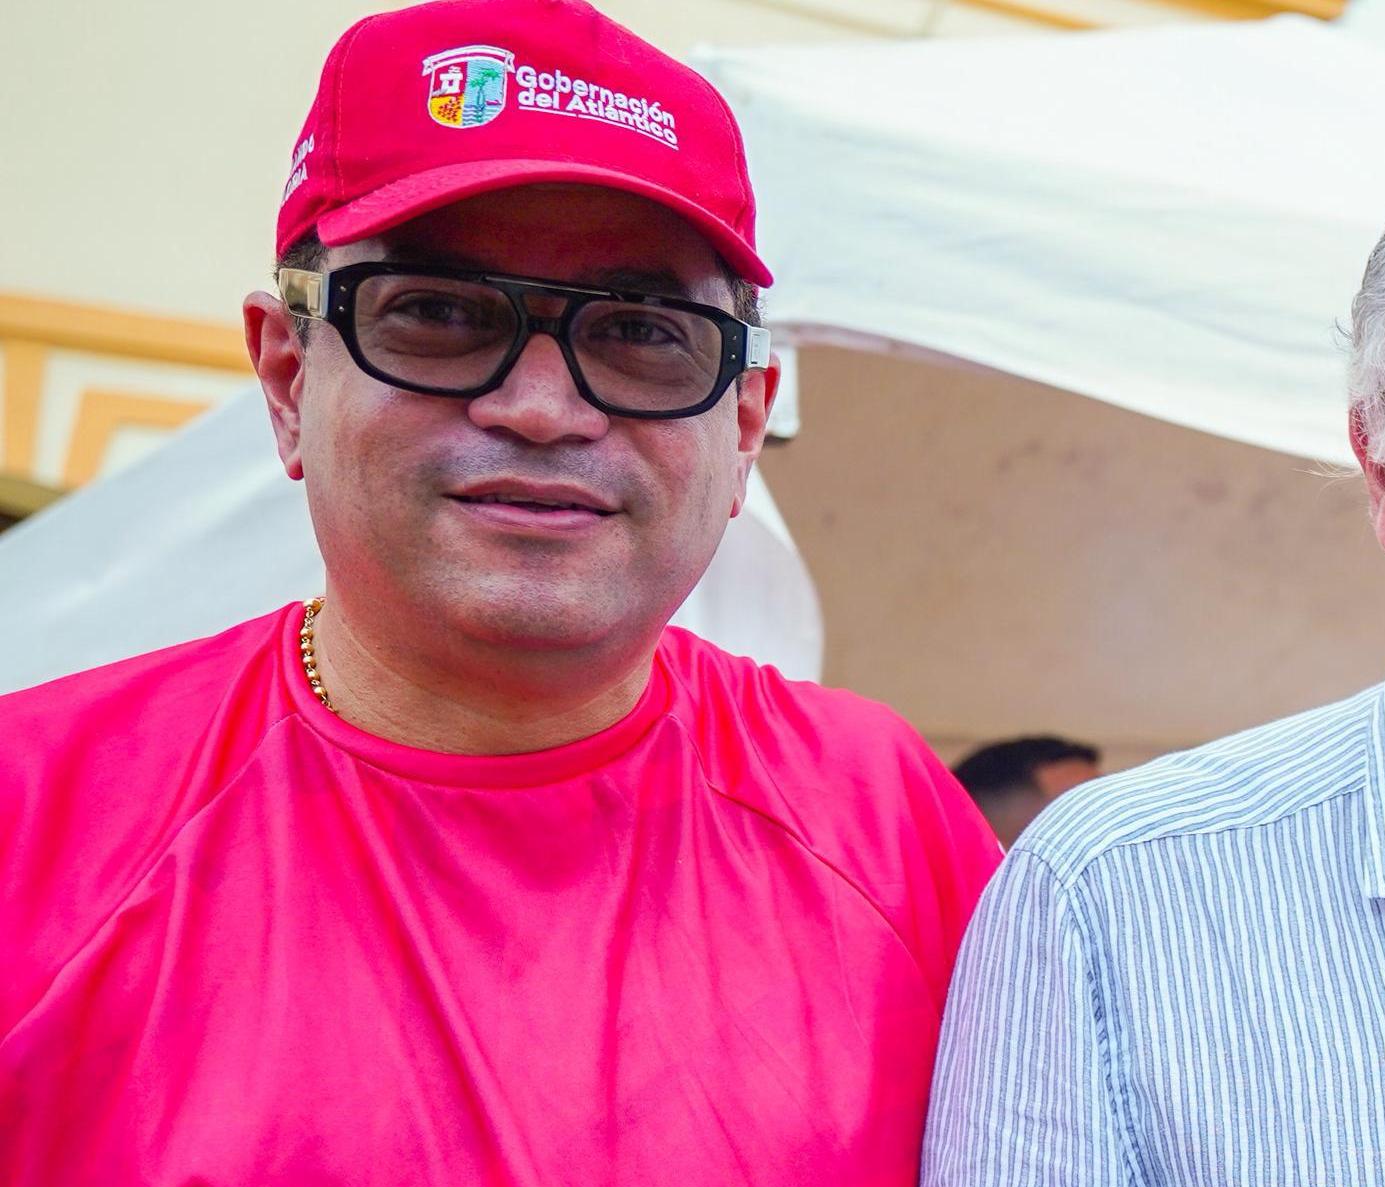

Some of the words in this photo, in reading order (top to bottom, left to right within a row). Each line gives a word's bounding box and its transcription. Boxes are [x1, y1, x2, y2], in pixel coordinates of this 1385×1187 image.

[515, 65, 676, 129] Gobernación
[518, 88, 561, 109] del
[565, 95, 679, 146] Atlántico
